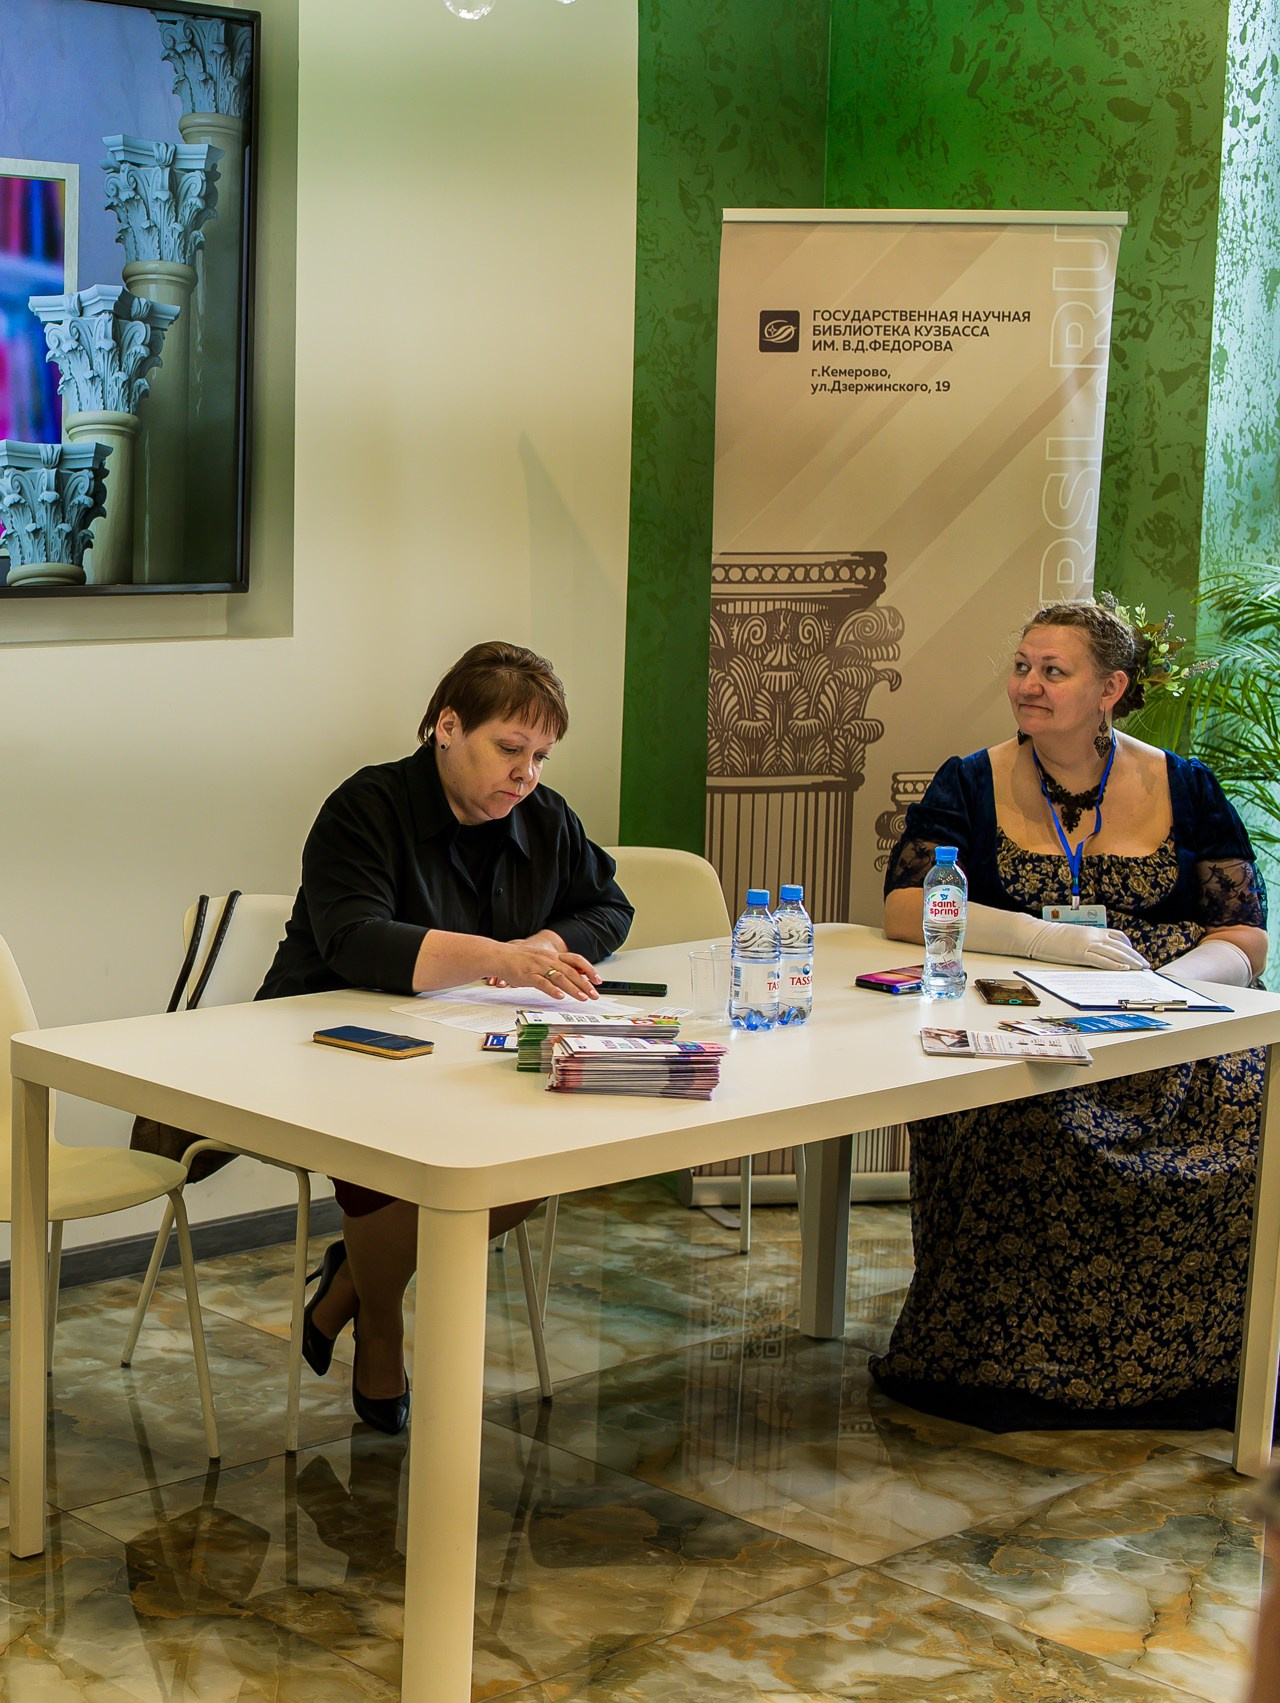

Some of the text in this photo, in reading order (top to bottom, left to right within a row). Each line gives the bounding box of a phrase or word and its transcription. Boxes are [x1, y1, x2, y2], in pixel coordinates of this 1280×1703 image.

[812, 309, 1031, 323] ГОСУДАРСТВЕННАЯ НАУЧНАЯ
[812, 324, 990, 337] БИБЛИОТЕКА КУЗБАССА
[812, 339, 953, 353] ИМ. В.Д.ФЕДОРОВА
[811, 365, 891, 380] г.Кемерово,
[811, 380, 951, 394] ул.Дзержинского, 19
[932, 900, 956, 908] saint
[930, 908, 959, 917] spring
